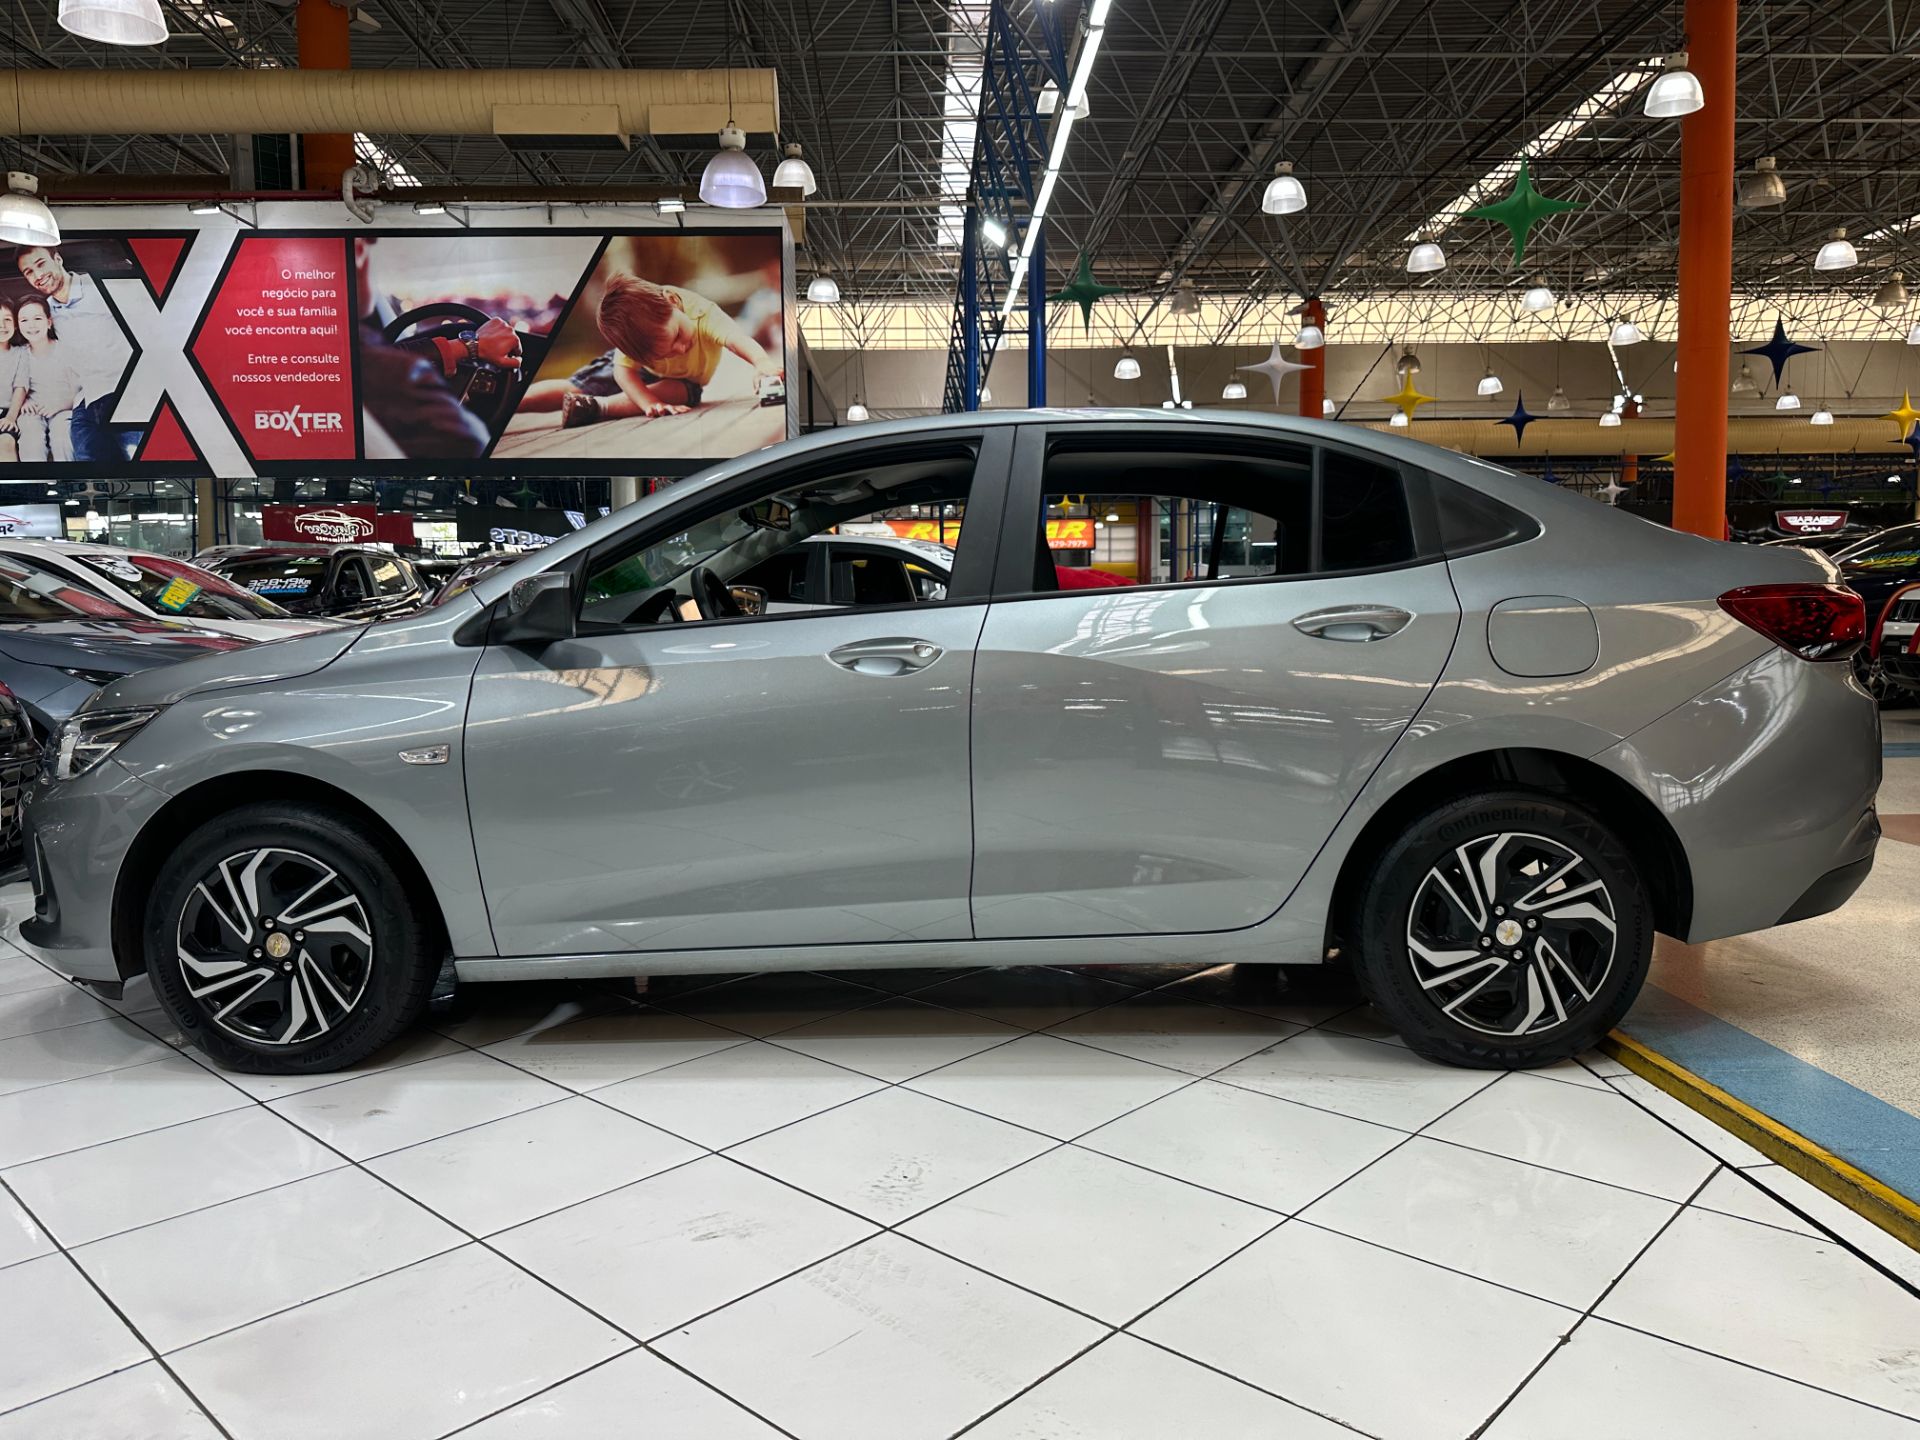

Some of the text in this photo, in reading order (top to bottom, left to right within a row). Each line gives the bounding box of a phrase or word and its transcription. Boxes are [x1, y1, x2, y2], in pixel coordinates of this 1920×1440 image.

[281, 269, 336, 280] O melhor
[262, 288, 337, 301] negócio para
[236, 306, 337, 317] você e sua família
[225, 325, 338, 336] você encontra aqui!
[247, 353, 340, 364] Entre e consulte
[232, 372, 341, 383] nossos vendedores
[254, 404, 343, 437] BOXTER
[1438, 807, 1537, 842] Continental
